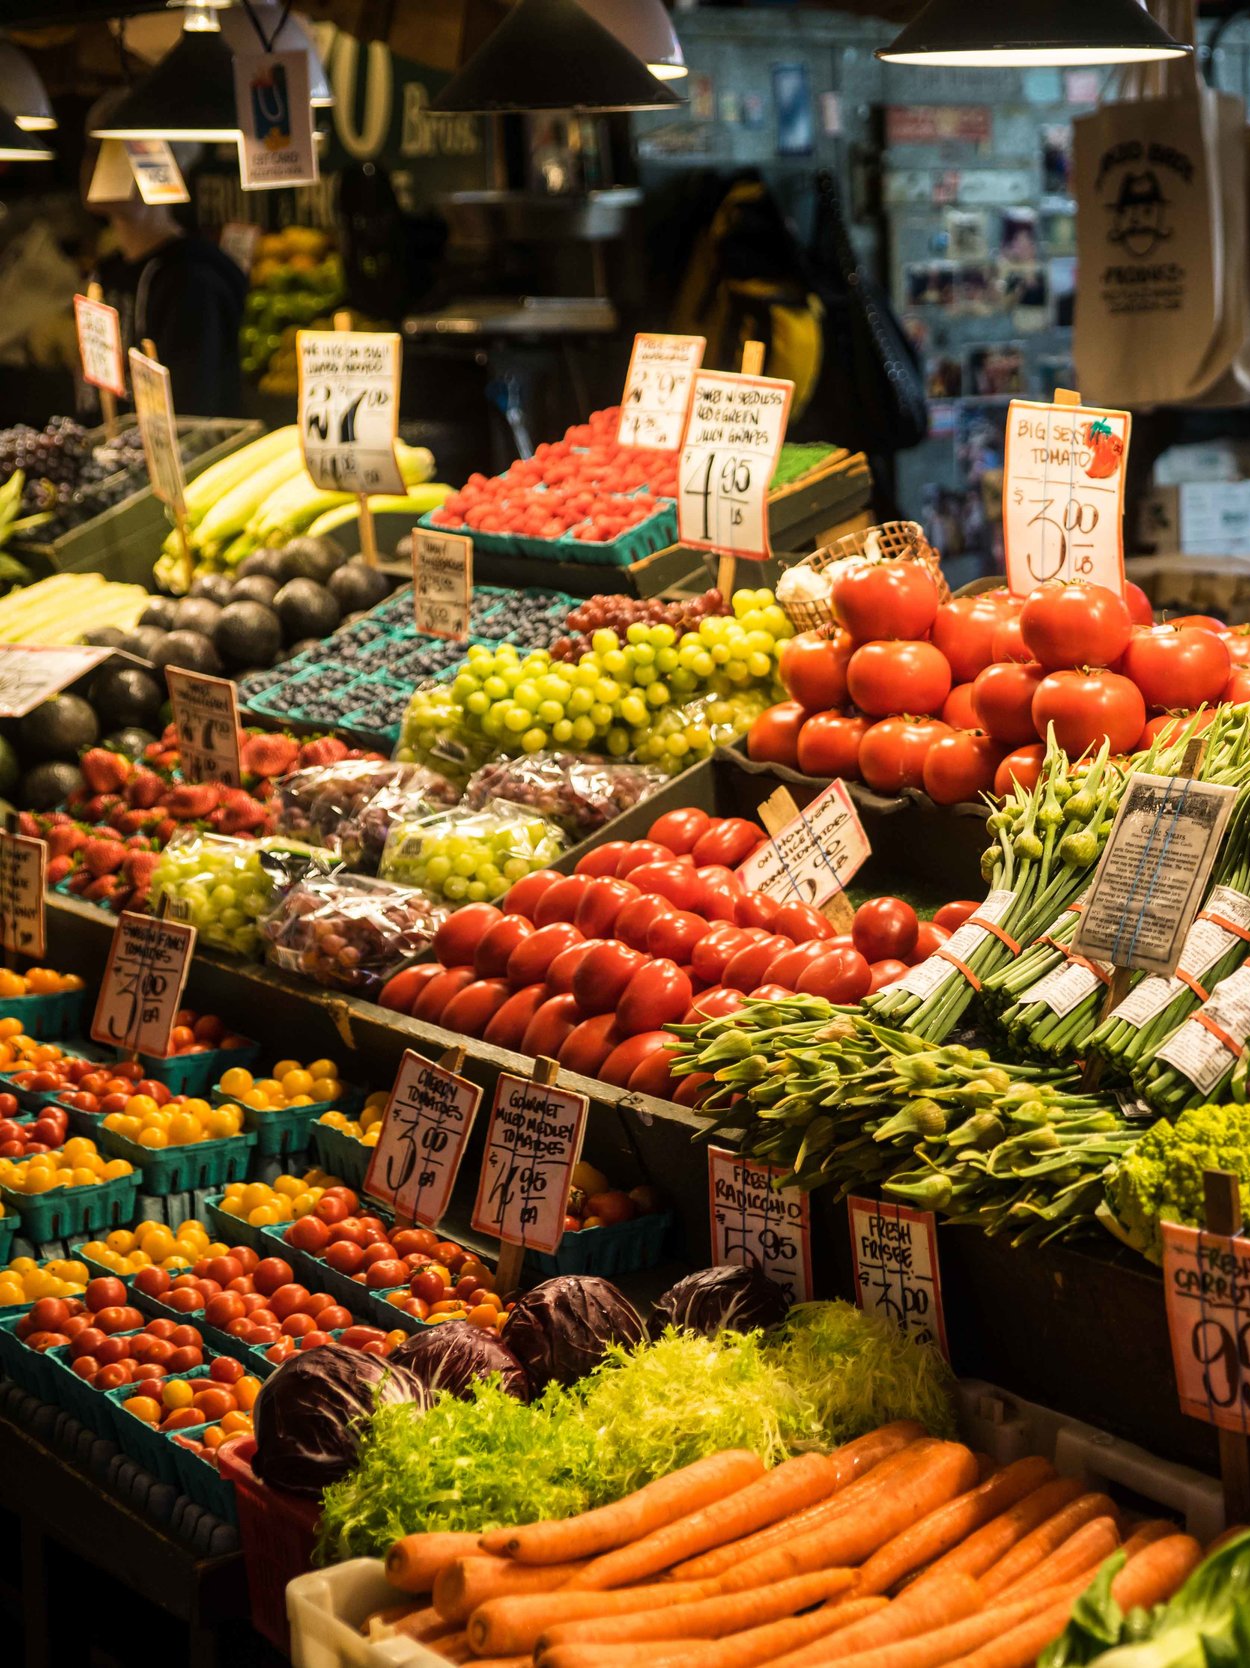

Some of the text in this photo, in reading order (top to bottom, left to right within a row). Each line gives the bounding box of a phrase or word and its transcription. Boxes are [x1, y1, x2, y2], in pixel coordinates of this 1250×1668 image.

[695, 387, 721, 405] SWEET
[738, 390, 783, 405] SEEDLESS
[722, 408, 759, 426] GREEN
[728, 428, 768, 446] GRAPES
[1018, 421, 1084, 445] BIG SEXY
[1031, 448, 1091, 468] TOMATO
[731, 507, 742, 525] LB
[1074, 555, 1093, 574] LB
[757, 850, 773, 869] OH
[807, 793, 835, 824] VERY
[1141, 825, 1162, 836] Garlic
[757, 812, 848, 893] ROMA TOMATOES
[832, 855, 849, 873] LB
[417, 1068, 458, 1100] CHERRY
[407, 1085, 463, 1121] TOMATOES
[509, 1090, 565, 1118] GOURMET
[503, 1129, 565, 1155] TOMATOES
[525, 1118, 573, 1143] MEDLEY
[733, 1165, 784, 1195] FRESH
[715, 1179, 801, 1219] RADICCHIO
[868, 1216, 912, 1245] FRESH
[861, 1236, 913, 1268] FRISEE
